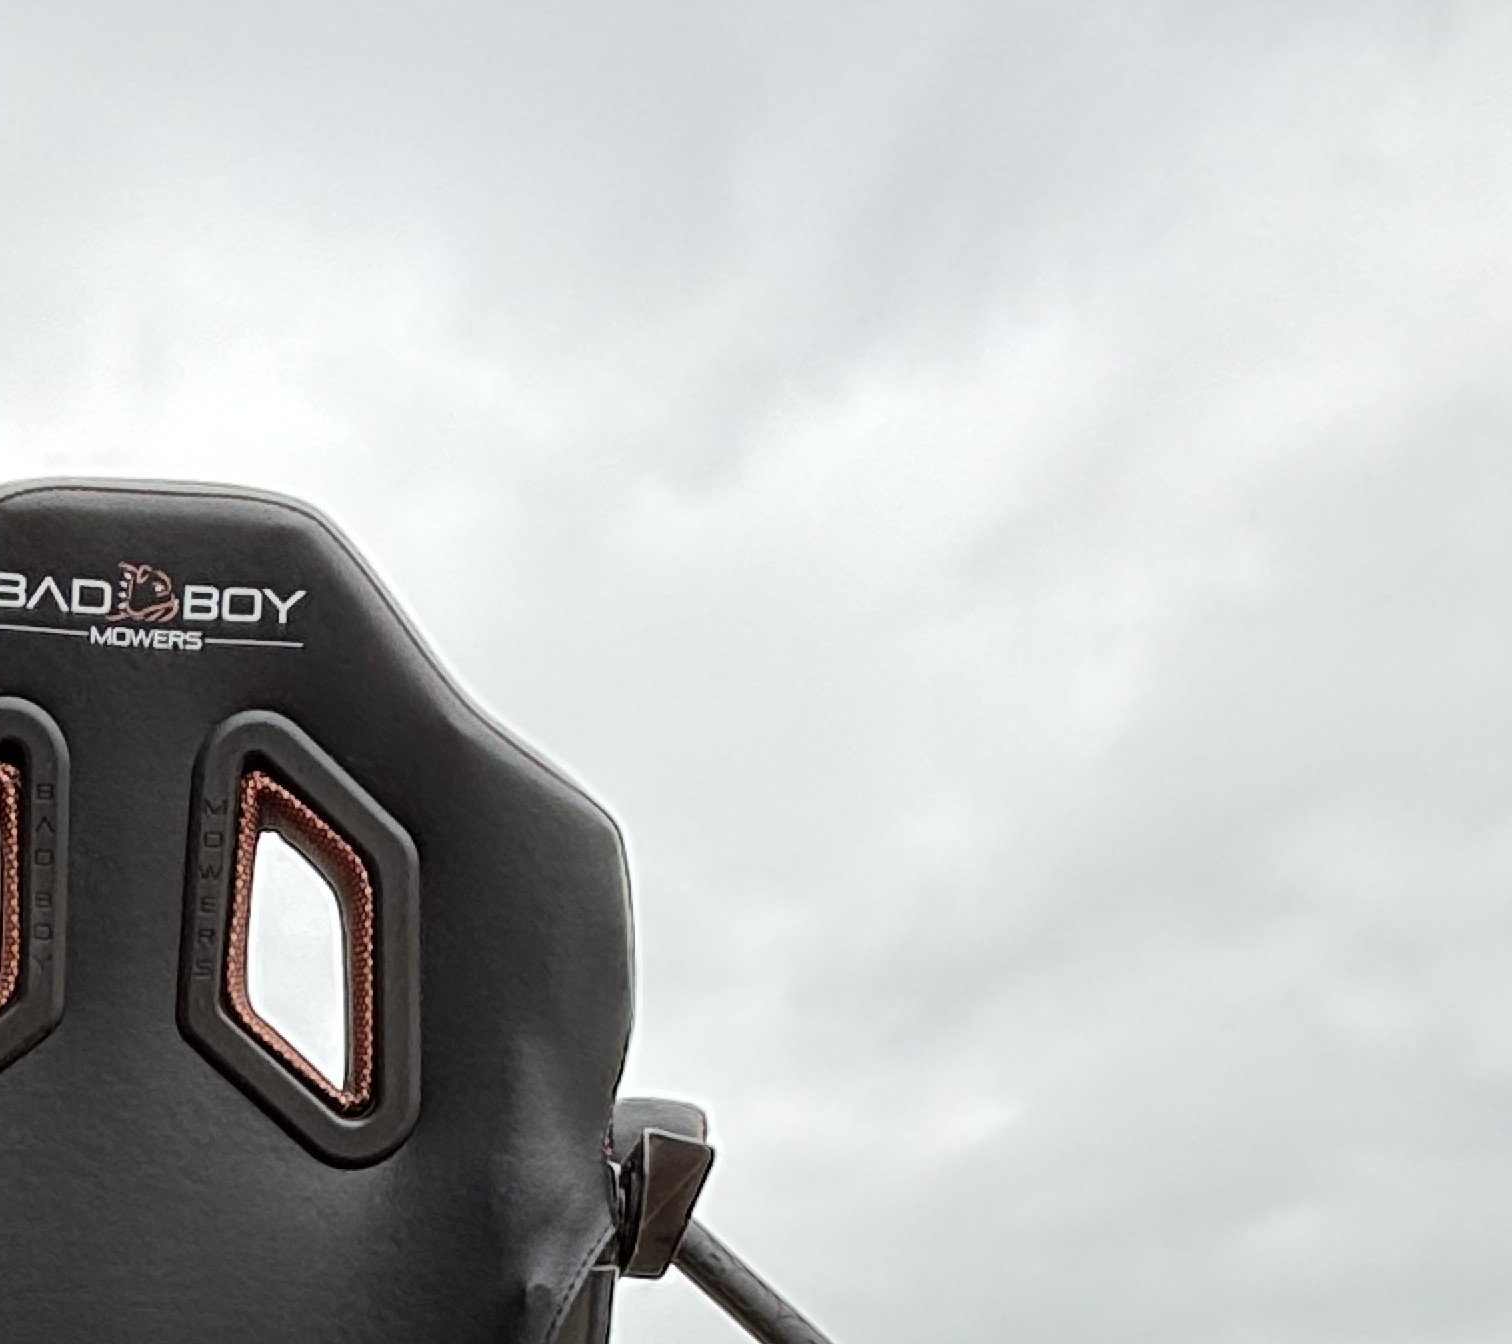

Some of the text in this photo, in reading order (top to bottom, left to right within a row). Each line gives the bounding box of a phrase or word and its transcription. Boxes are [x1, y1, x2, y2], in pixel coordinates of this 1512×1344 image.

[182, 584, 308, 624] BOY
[90, 626, 203, 651] MOWERS
[194, 798, 228, 980] MOWERS
